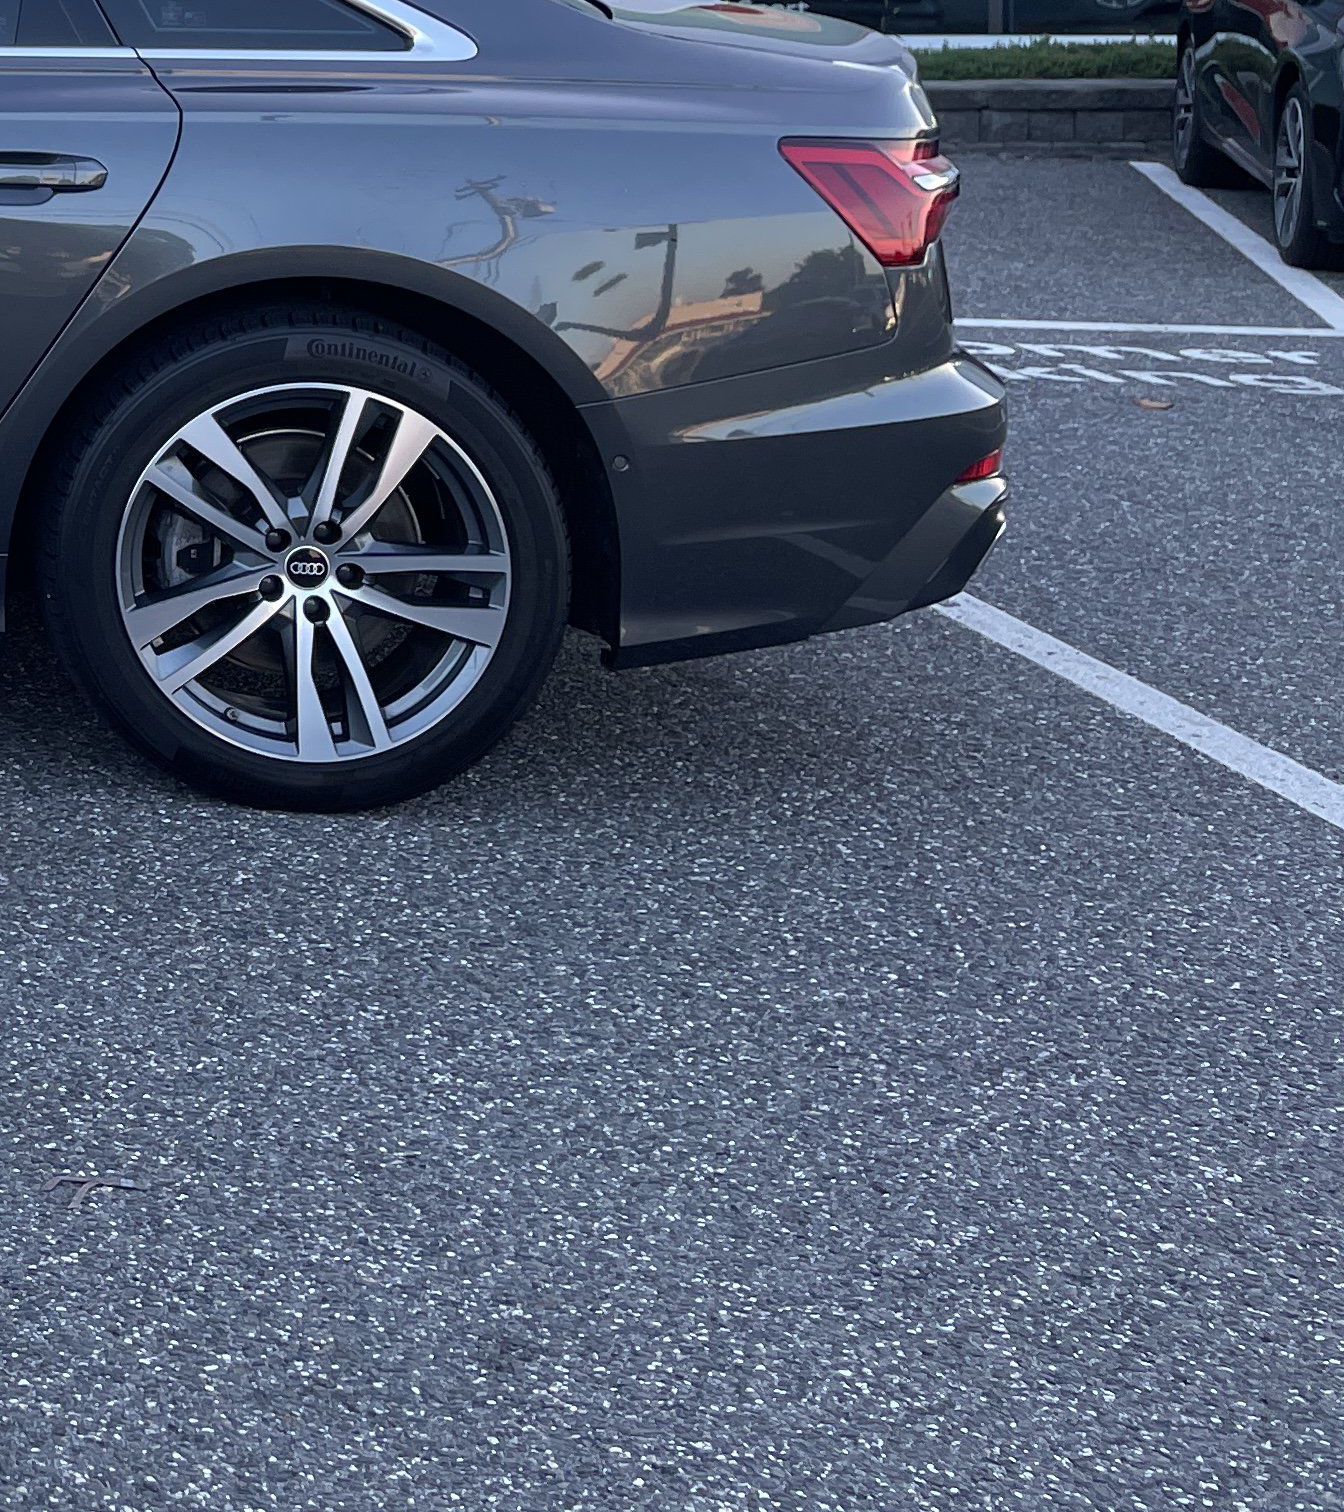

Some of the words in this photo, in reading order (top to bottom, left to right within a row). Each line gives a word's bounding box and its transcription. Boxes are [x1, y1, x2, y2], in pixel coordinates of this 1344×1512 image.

[306, 338, 417, 376] Continental
[955, 340, 1319, 365] omer
[983, 361, 1344, 395] king
